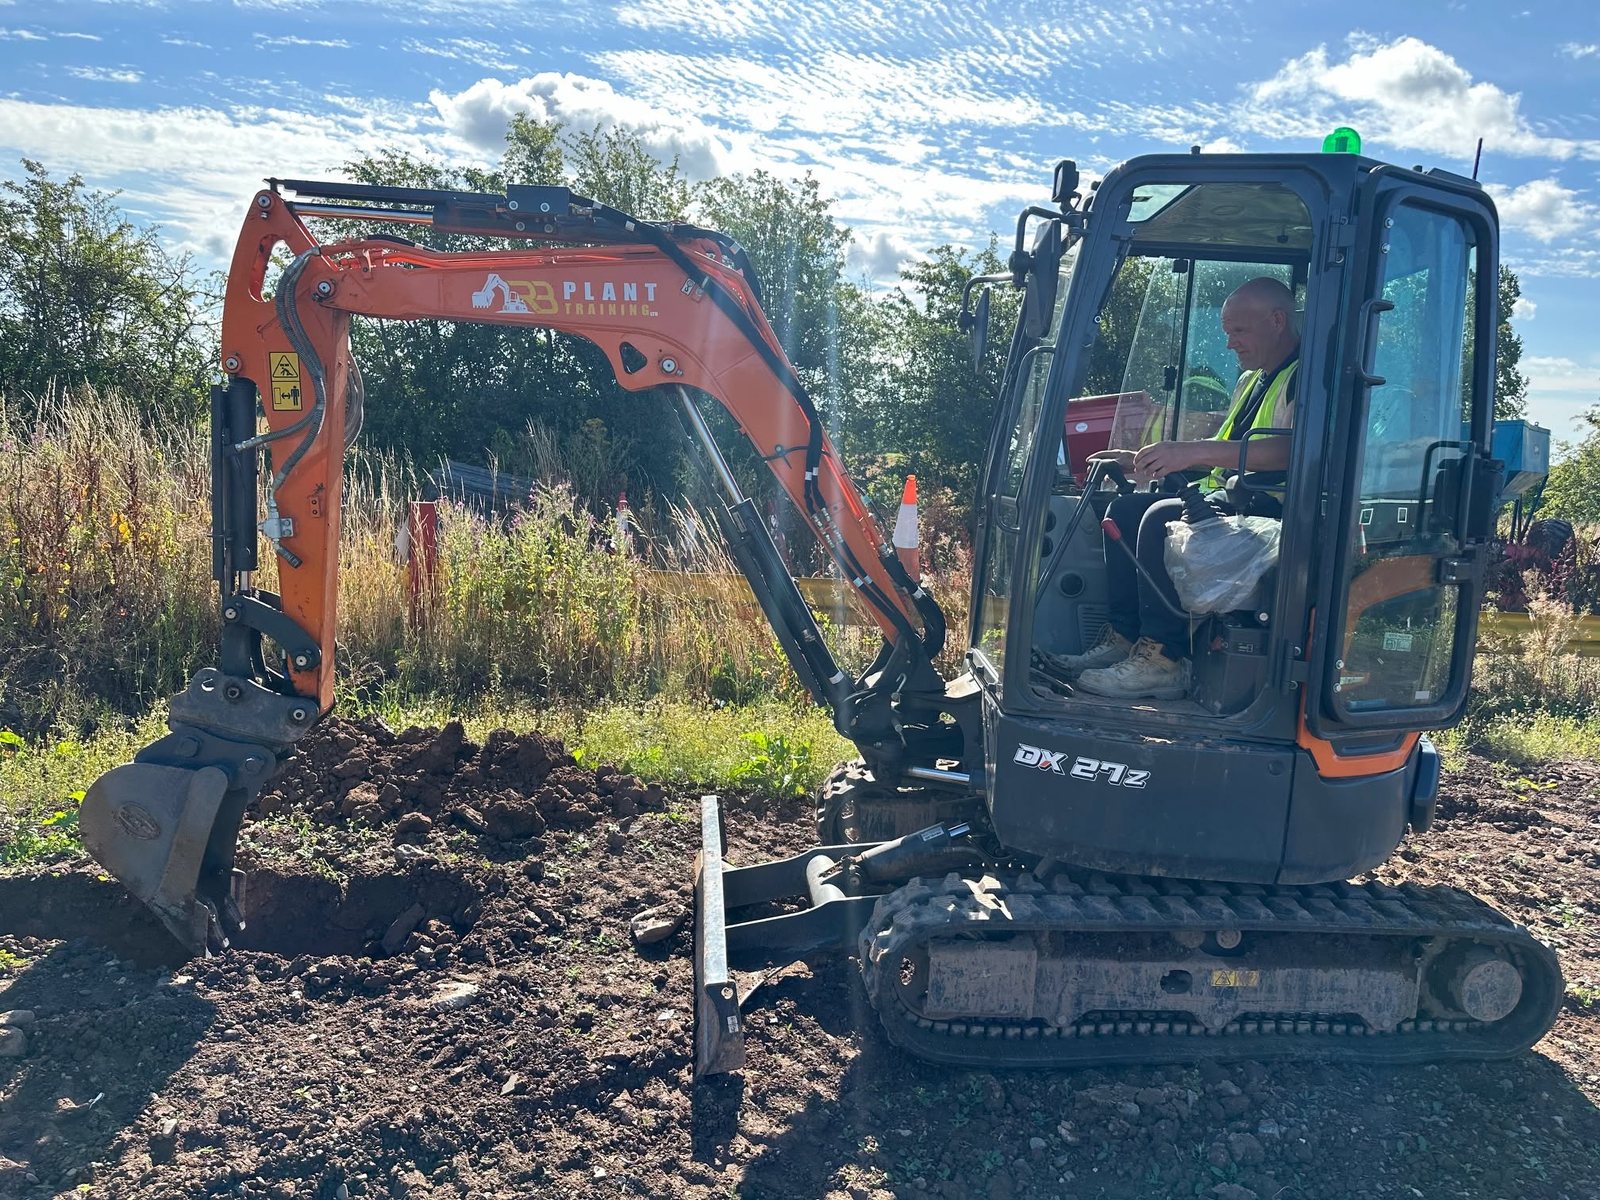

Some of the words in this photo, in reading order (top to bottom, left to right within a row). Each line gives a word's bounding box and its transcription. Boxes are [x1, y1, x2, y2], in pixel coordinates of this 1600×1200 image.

[563, 281, 657, 301] PLANT
[565, 303, 649, 316] TRAINING
[1013, 742, 1069, 776] DX
